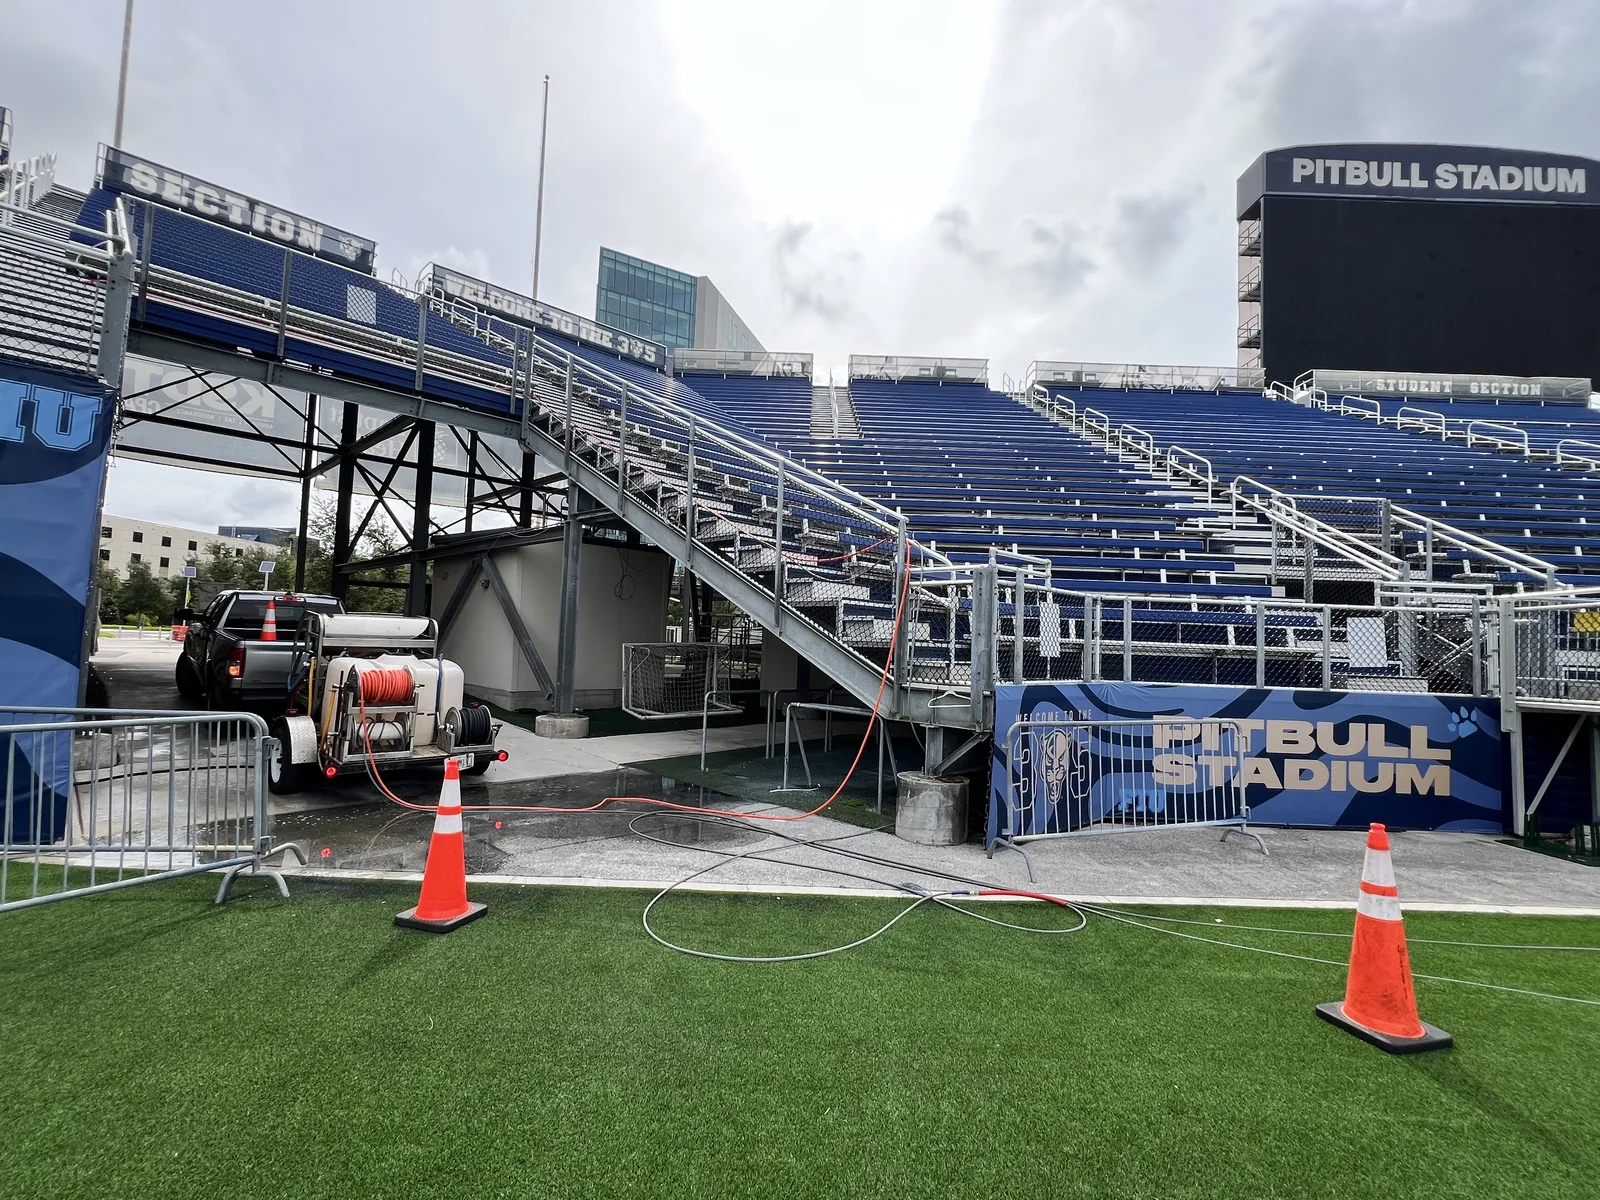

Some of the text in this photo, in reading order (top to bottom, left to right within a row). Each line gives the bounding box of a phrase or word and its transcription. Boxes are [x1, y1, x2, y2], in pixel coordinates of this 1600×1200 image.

[1292, 157, 1587, 194] PITBULL STADIUM
[130, 162, 324, 251] SECTION
[445, 273, 656, 363] WELCOME TO THE 35
[1375, 379, 1542, 396] STUDENT SECTION
[1015, 708, 1092, 722] WELCOME TO THE
[1152, 715, 1452, 760] PITBULL
[1011, 725, 1093, 812] 35
[1151, 752, 1451, 796] STADIUM
